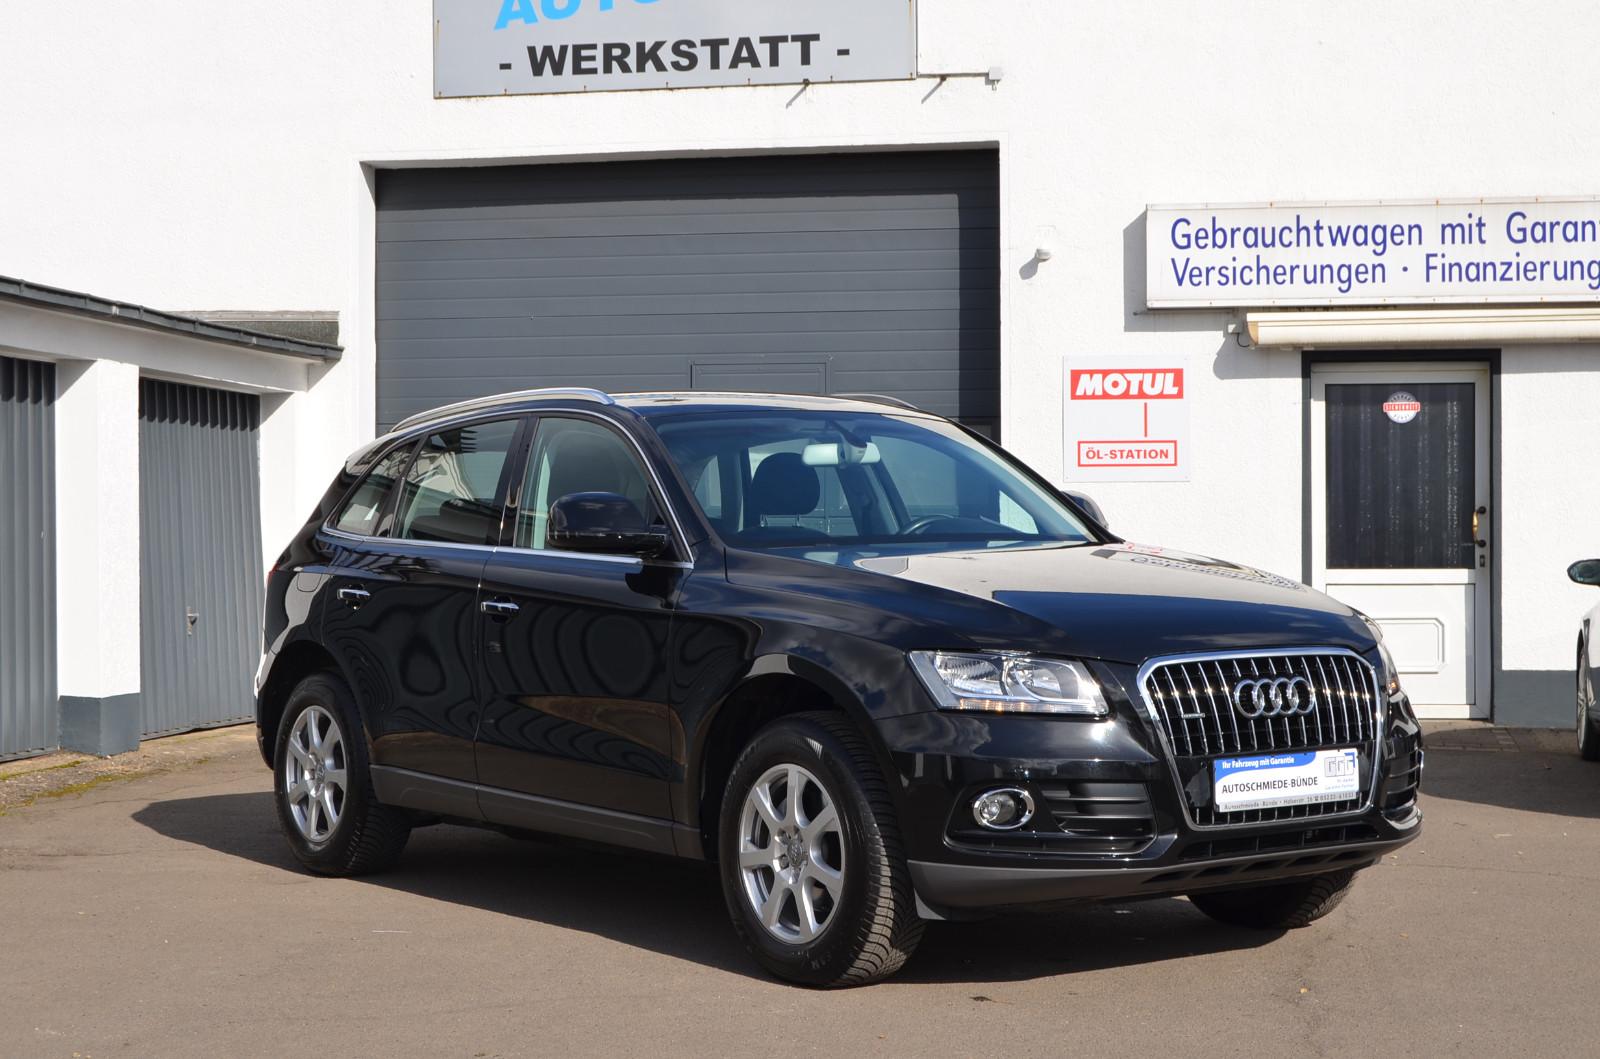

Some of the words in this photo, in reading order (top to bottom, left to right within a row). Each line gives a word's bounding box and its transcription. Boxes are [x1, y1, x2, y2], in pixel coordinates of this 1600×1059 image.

[526, 33, 821, 77] WERKSTATT
[1170, 215, 1423, 256] Gebrauchtwagen
[1440, 213, 1486, 244] mit
[1506, 212, 1600, 244] Garan
[1171, 255, 1387, 293] Versicherungen
[1075, 372, 1179, 396] MOTUL
[1085, 447, 1169, 460] ÖL-STATION
[1222, 761, 1231, 769] Ihr
[1232, 759, 1259, 768] Fahrzeug
[1260, 757, 1270, 766] mit
[1270, 756, 1295, 765] Garantie
[1221, 776, 1319, 794] AUTOSCHMIEDE-BÜNDE
